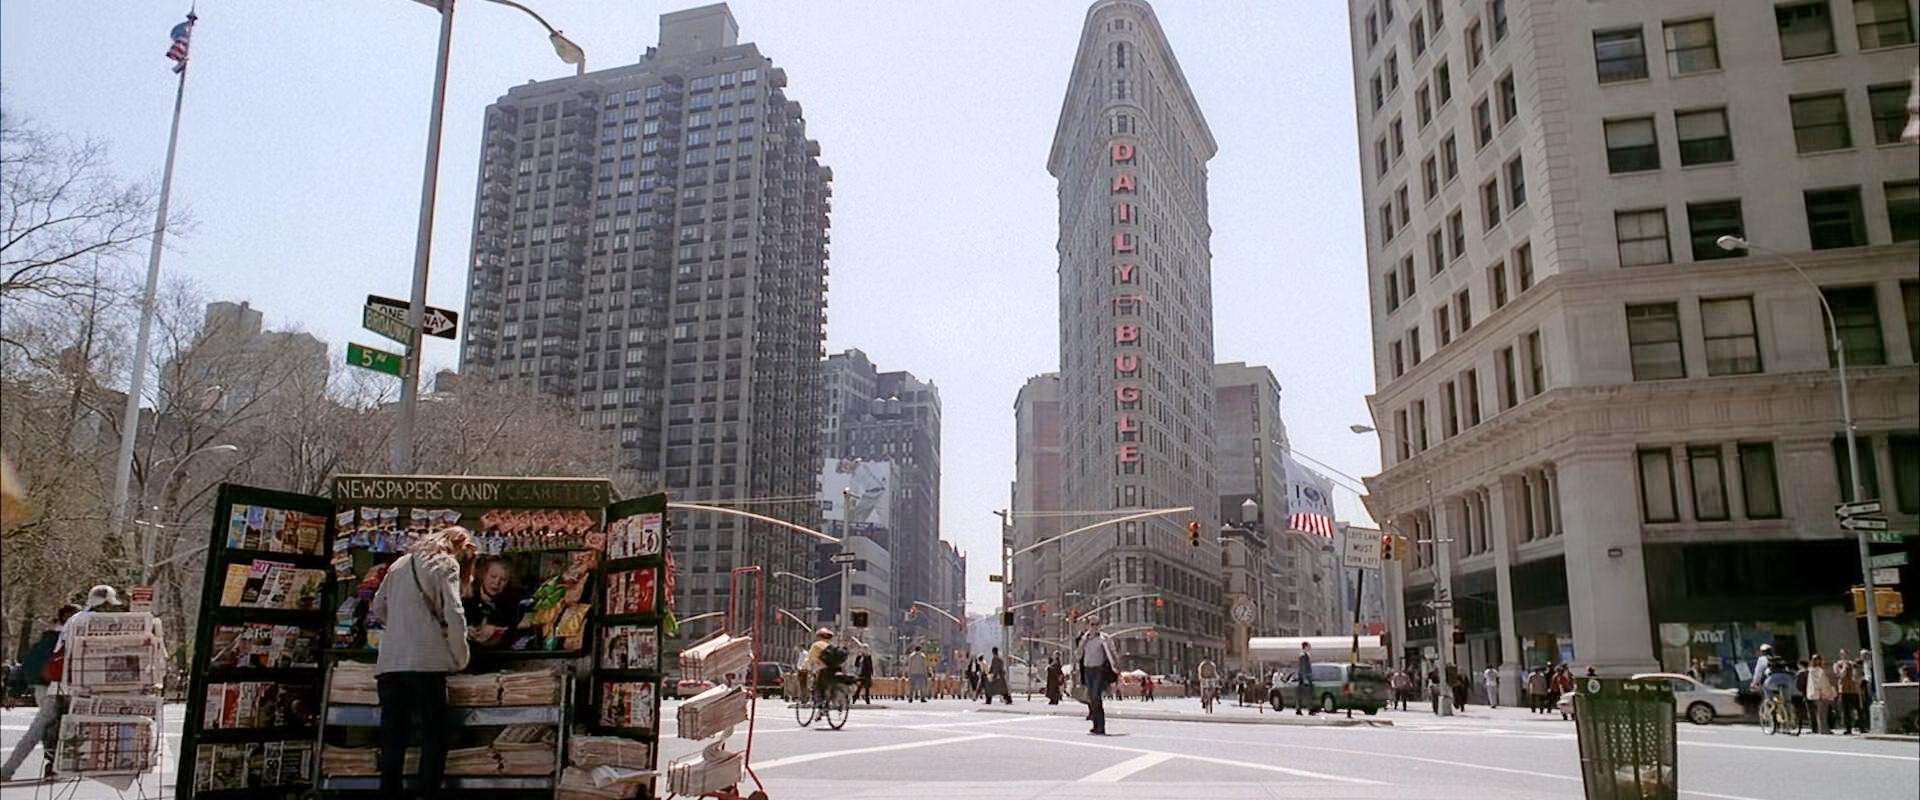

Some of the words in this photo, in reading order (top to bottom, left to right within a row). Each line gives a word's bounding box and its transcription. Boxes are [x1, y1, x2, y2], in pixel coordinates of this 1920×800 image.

[1112, 143, 1136, 283] DAILY
[380, 306, 405, 321] ONE
[361, 349, 374, 367] 5
[1115, 322, 1140, 463] BUGLE
[337, 480, 443, 500] NEWSPAPERS
[450, 482, 500, 501] CANDY
[1353, 543, 1374, 553] MUST
[1694, 629, 1725, 643] AT&T
